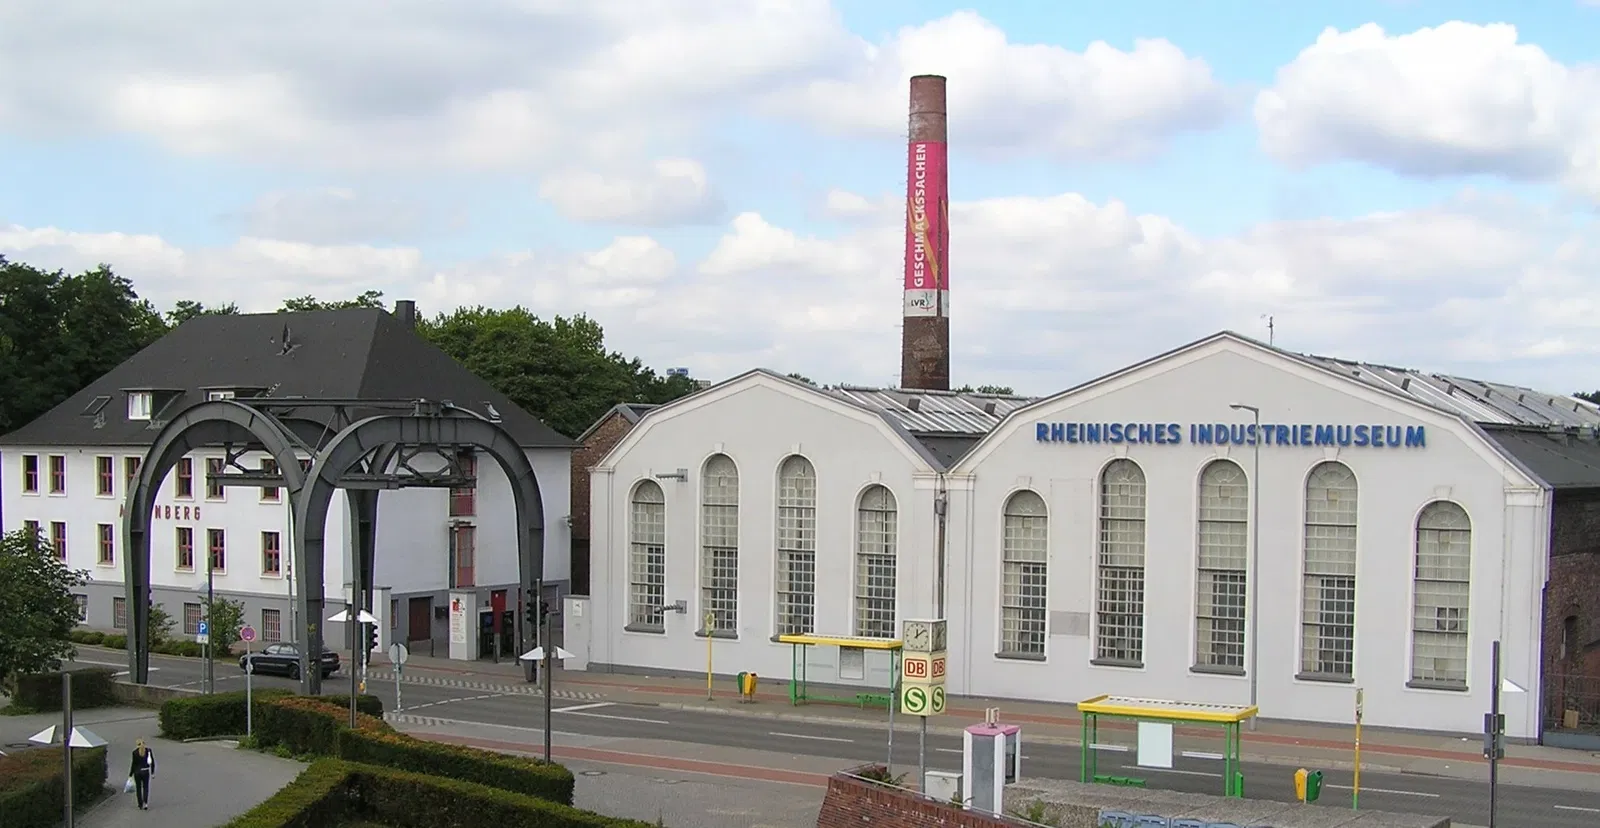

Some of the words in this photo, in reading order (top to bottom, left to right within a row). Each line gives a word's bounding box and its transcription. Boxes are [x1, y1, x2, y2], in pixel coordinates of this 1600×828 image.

[913, 143, 926, 287] GESCHMACKSSACHEN
[911, 299, 925, 307] LVR
[1036, 422, 1181, 444] RHEINISCHES
[1190, 423, 1426, 448] INDUSTRIEMUSEUM
[200, 623, 206, 632] P
[907, 662, 924, 674] DB
[934, 661, 944, 673] DB
